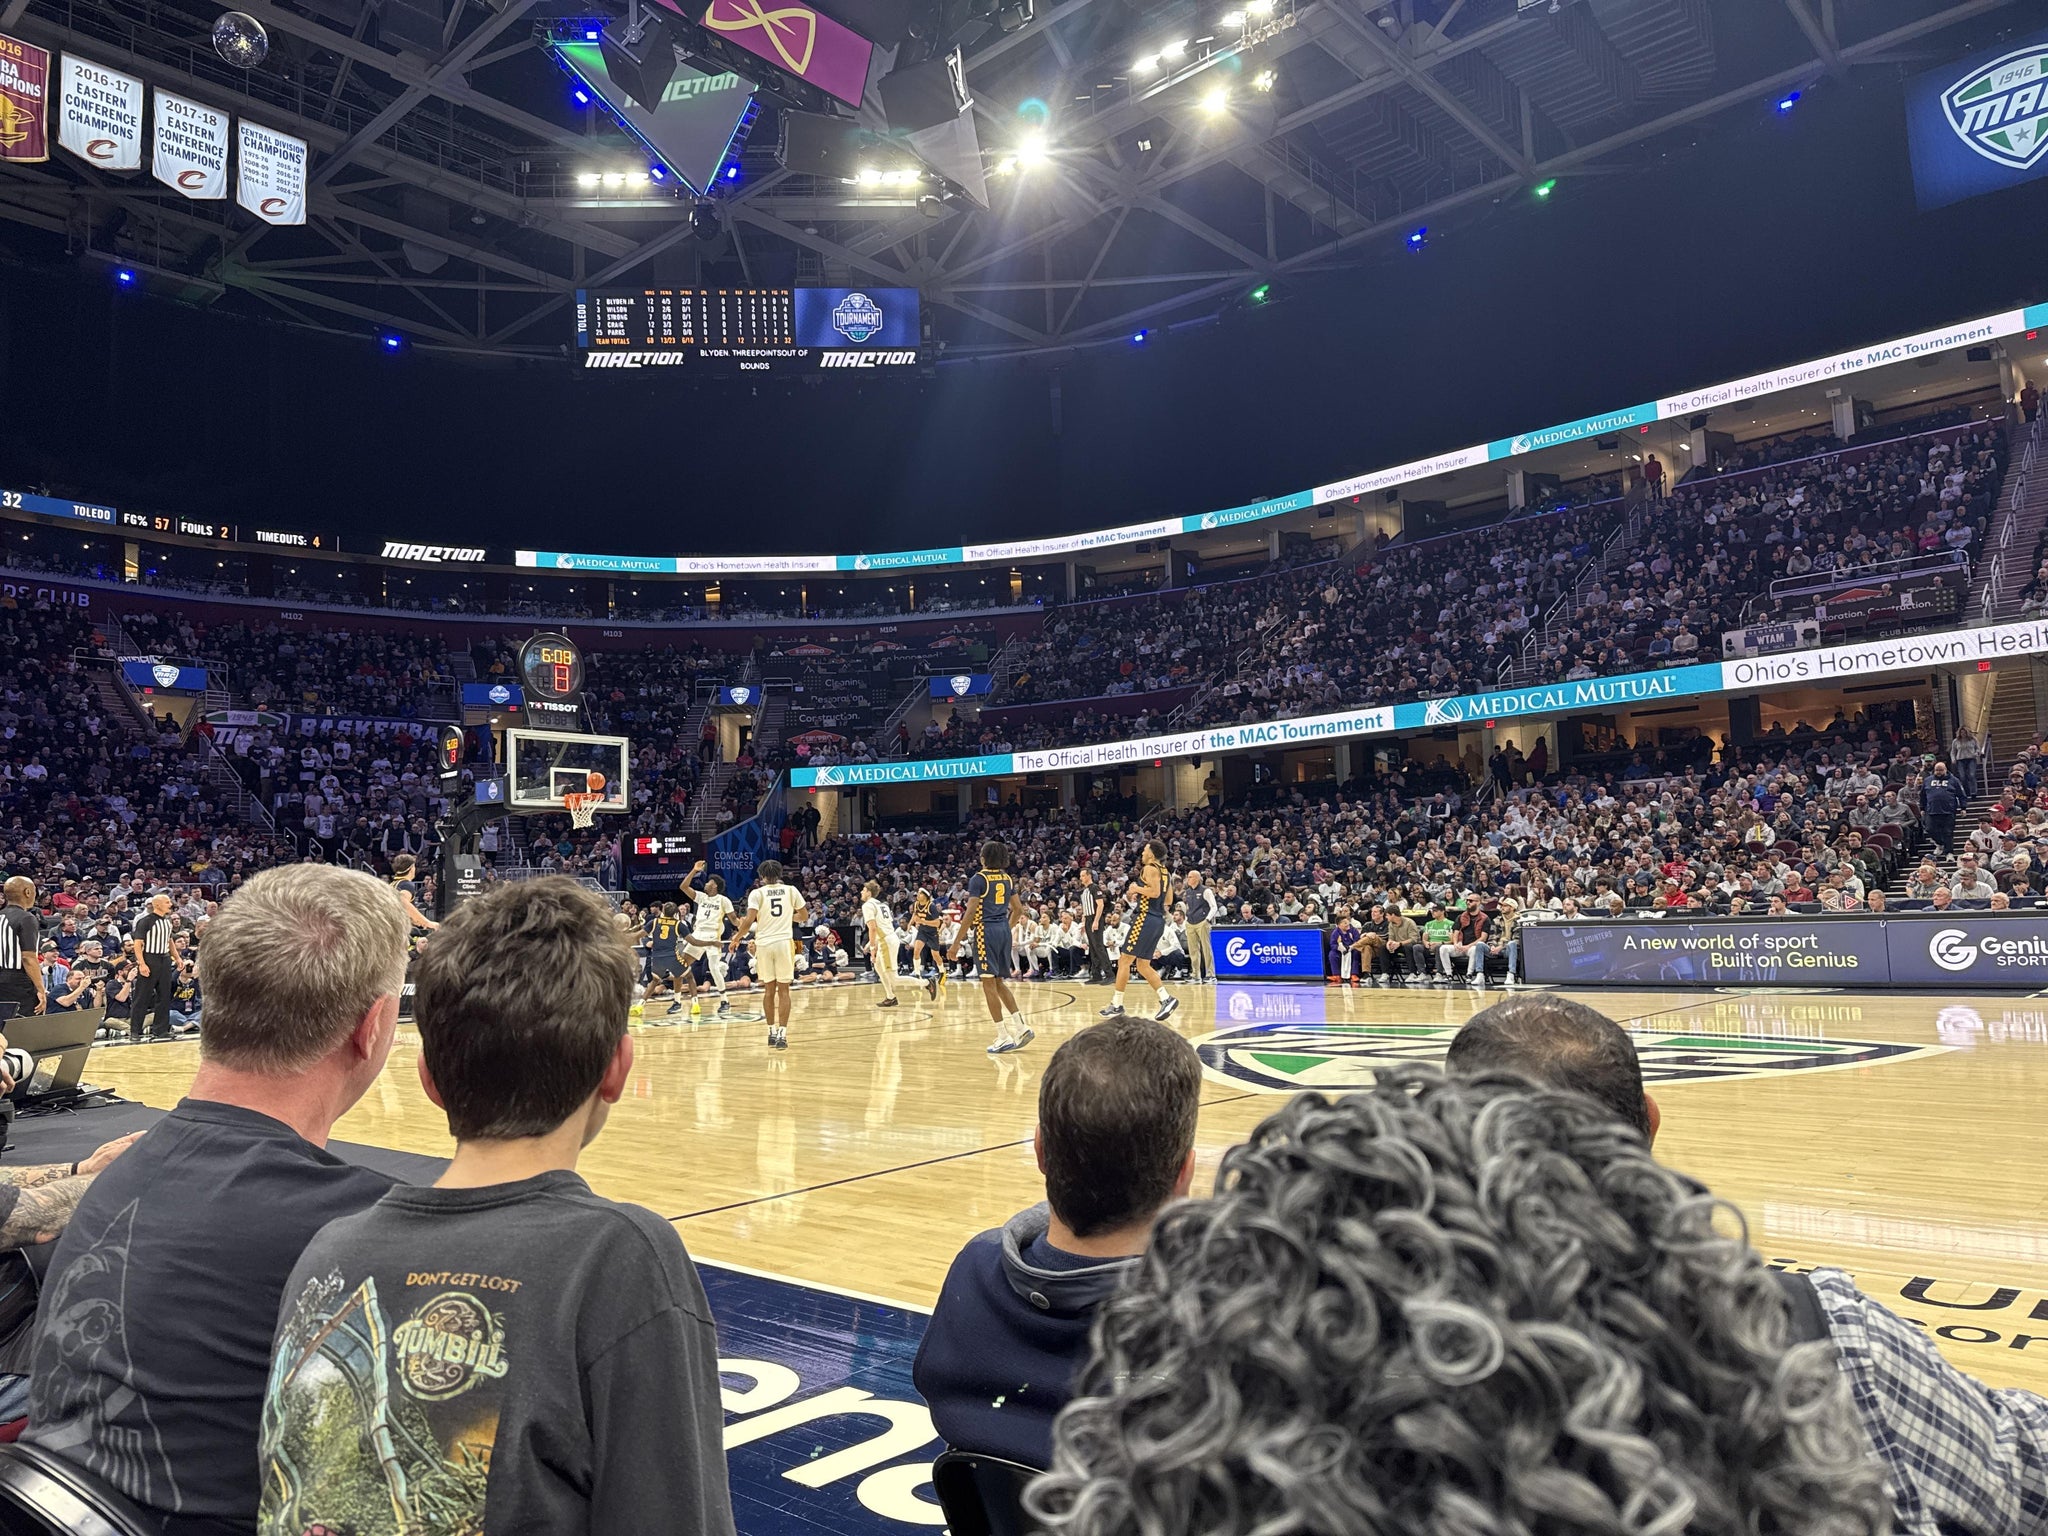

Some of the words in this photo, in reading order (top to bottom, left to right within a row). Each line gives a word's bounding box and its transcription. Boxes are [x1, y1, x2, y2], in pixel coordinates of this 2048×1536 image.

[75, 66, 130, 93] 2016-17
[1999, 64, 2035, 86] 1946
[77, 83, 127, 109] EASTERN
[66, 94, 137, 127] CONFERENCE
[166, 100, 217, 126] 2017-18
[68, 110, 133, 140] CHAMPIONS
[168, 117, 215, 141] EASTERN
[159, 127, 224, 159] CONFERENCE
[241, 127, 271, 144] CENTRAL
[275, 139, 305, 155] DIVISION
[244, 138, 301, 165] CHAMPIONS
[161, 142, 221, 171] CHAMPIONS
[577, 304, 587, 332] TOLEDO
[836, 313, 880, 327] TOURNAMENT
[1667, 402, 1688, 413] The
[1691, 389, 1731, 407] Official
[1735, 379, 1773, 397] Health
[1778, 368, 1819, 386] Insurer
[1824, 362, 1837, 375] of
[1841, 358, 1863, 370] the
[1867, 347, 1901, 364] MAC
[1904, 325, 1992, 355] Tournament
[1533, 429, 1583, 446] MEDICAL
[1586, 414, 1635, 433] MUTUAL
[1325, 487, 1351, 498] Ohio's
[1354, 473, 1401, 491] Hometown
[1404, 465, 1433, 479] Health
[1436, 456, 1468, 470] Insurer
[3, 492, 22, 509] 32
[73, 505, 111, 520] TOLEDO
[1220, 510, 1259, 524] MEDICAL
[1262, 499, 1297, 514] MUTUAL
[124, 513, 148, 527] FG%
[155, 517, 169, 531] 57
[181, 522, 213, 536] FOULS
[221, 526, 229, 539] 2
[256, 531, 307, 546] TIMEOUTS:
[313, 536, 320, 548] 4
[970, 550, 984, 558] The
[1015, 545, 1040, 554] Health
[1081, 539, 1094, 547] the
[1096, 534, 1116, 544] MAC
[1117, 527, 1166, 540] Tournament
[576, 558, 619, 568] MEDICAL
[621, 560, 660, 570] MUTUAL
[872, 556, 909, 567] MEDICAL
[912, 553, 947, 563] MUTUAL
[281, 613, 303, 621] M102
[603, 630, 623, 638] M103
[1756, 632, 1785, 645] WTAM
[1903, 625, 1928, 633] LEVEL
[542, 648, 572, 665] 6:08
[1735, 658, 1809, 683] Ohio's
[1819, 641, 1965, 674] Hometown
[555, 665, 569, 692] 8
[1468, 689, 1569, 717] MEDICAL
[1575, 676, 1676, 704] MUTUAL
[543, 702, 578, 713] TISSOT
[1018, 756, 1043, 770] The
[1048, 752, 1094, 768] Official
[1098, 744, 1138, 764] Health
[1142, 739, 1188, 757] Insurer
[1192, 736, 1206, 750] of
[1210, 733, 1235, 748] the
[1239, 726, 1278, 745] MAC
[1280, 713, 1383, 740] Tournament
[848, 767, 919, 782] MEDICAL
[924, 761, 986, 778] MUTUAL
[714, 851, 754, 860] COMCAST
[715, 861, 754, 870] BUSINESS
[995, 883, 1006, 905] 2
[704, 911, 711, 919] 4
[770, 898, 783, 917] 5
[660, 925, 670, 940] 3
[1623, 935, 1637, 950] A
[1640, 938, 1678, 950] new
[1681, 934, 1735, 950] world
[1739, 934, 1760, 949] of
[1764, 934, 1818, 952] sport
[1252, 942, 1298, 956] Genius
[1260, 956, 1292, 964] SPORTS
[1711, 952, 1753, 968] Built
[1757, 955, 1782, 968] on
[1787, 952, 1858, 968] Genius
[450, 1273, 481, 1287] GET
[480, 1275, 523, 1294] LOST
